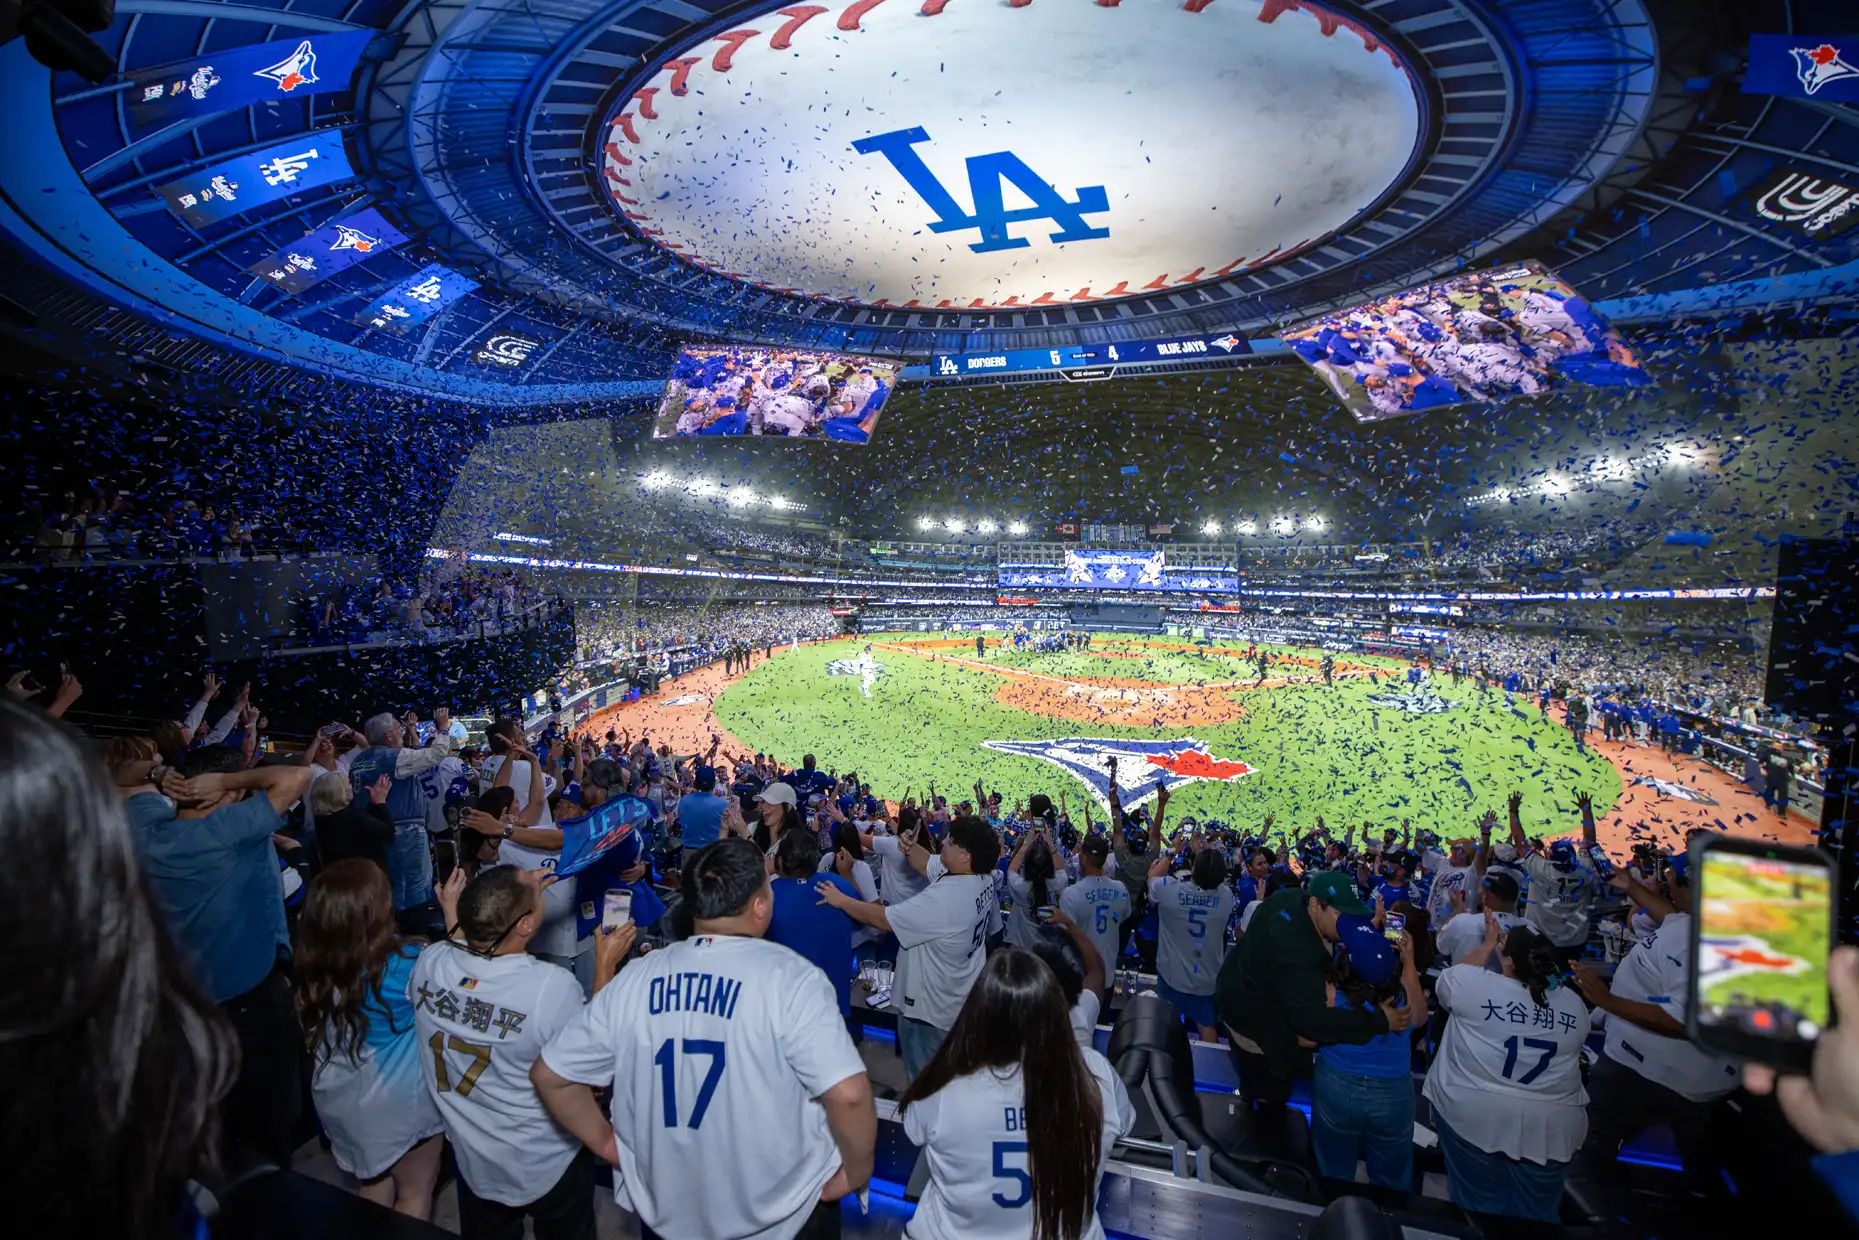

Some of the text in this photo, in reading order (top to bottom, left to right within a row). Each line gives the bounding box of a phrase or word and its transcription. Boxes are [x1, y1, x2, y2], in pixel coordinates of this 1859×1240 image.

[260, 149, 318, 186] LA
[851, 126, 1110, 254] LA
[407, 276, 441, 303] LA
[940, 351, 1061, 375] LA DODGERS 5
[1109, 341, 1208, 360] 4 BLUE JAYS
[420, 775, 439, 800] 5
[1187, 908, 1208, 938] 5
[416, 980, 527, 1040] 大谷翔平
[649, 972, 742, 1020] OHTANI
[1480, 999, 1577, 1034] 大谷翔平
[429, 1030, 492, 1097] 17
[1502, 1035, 1558, 1085] 17
[654, 1037, 725, 1130] 17
